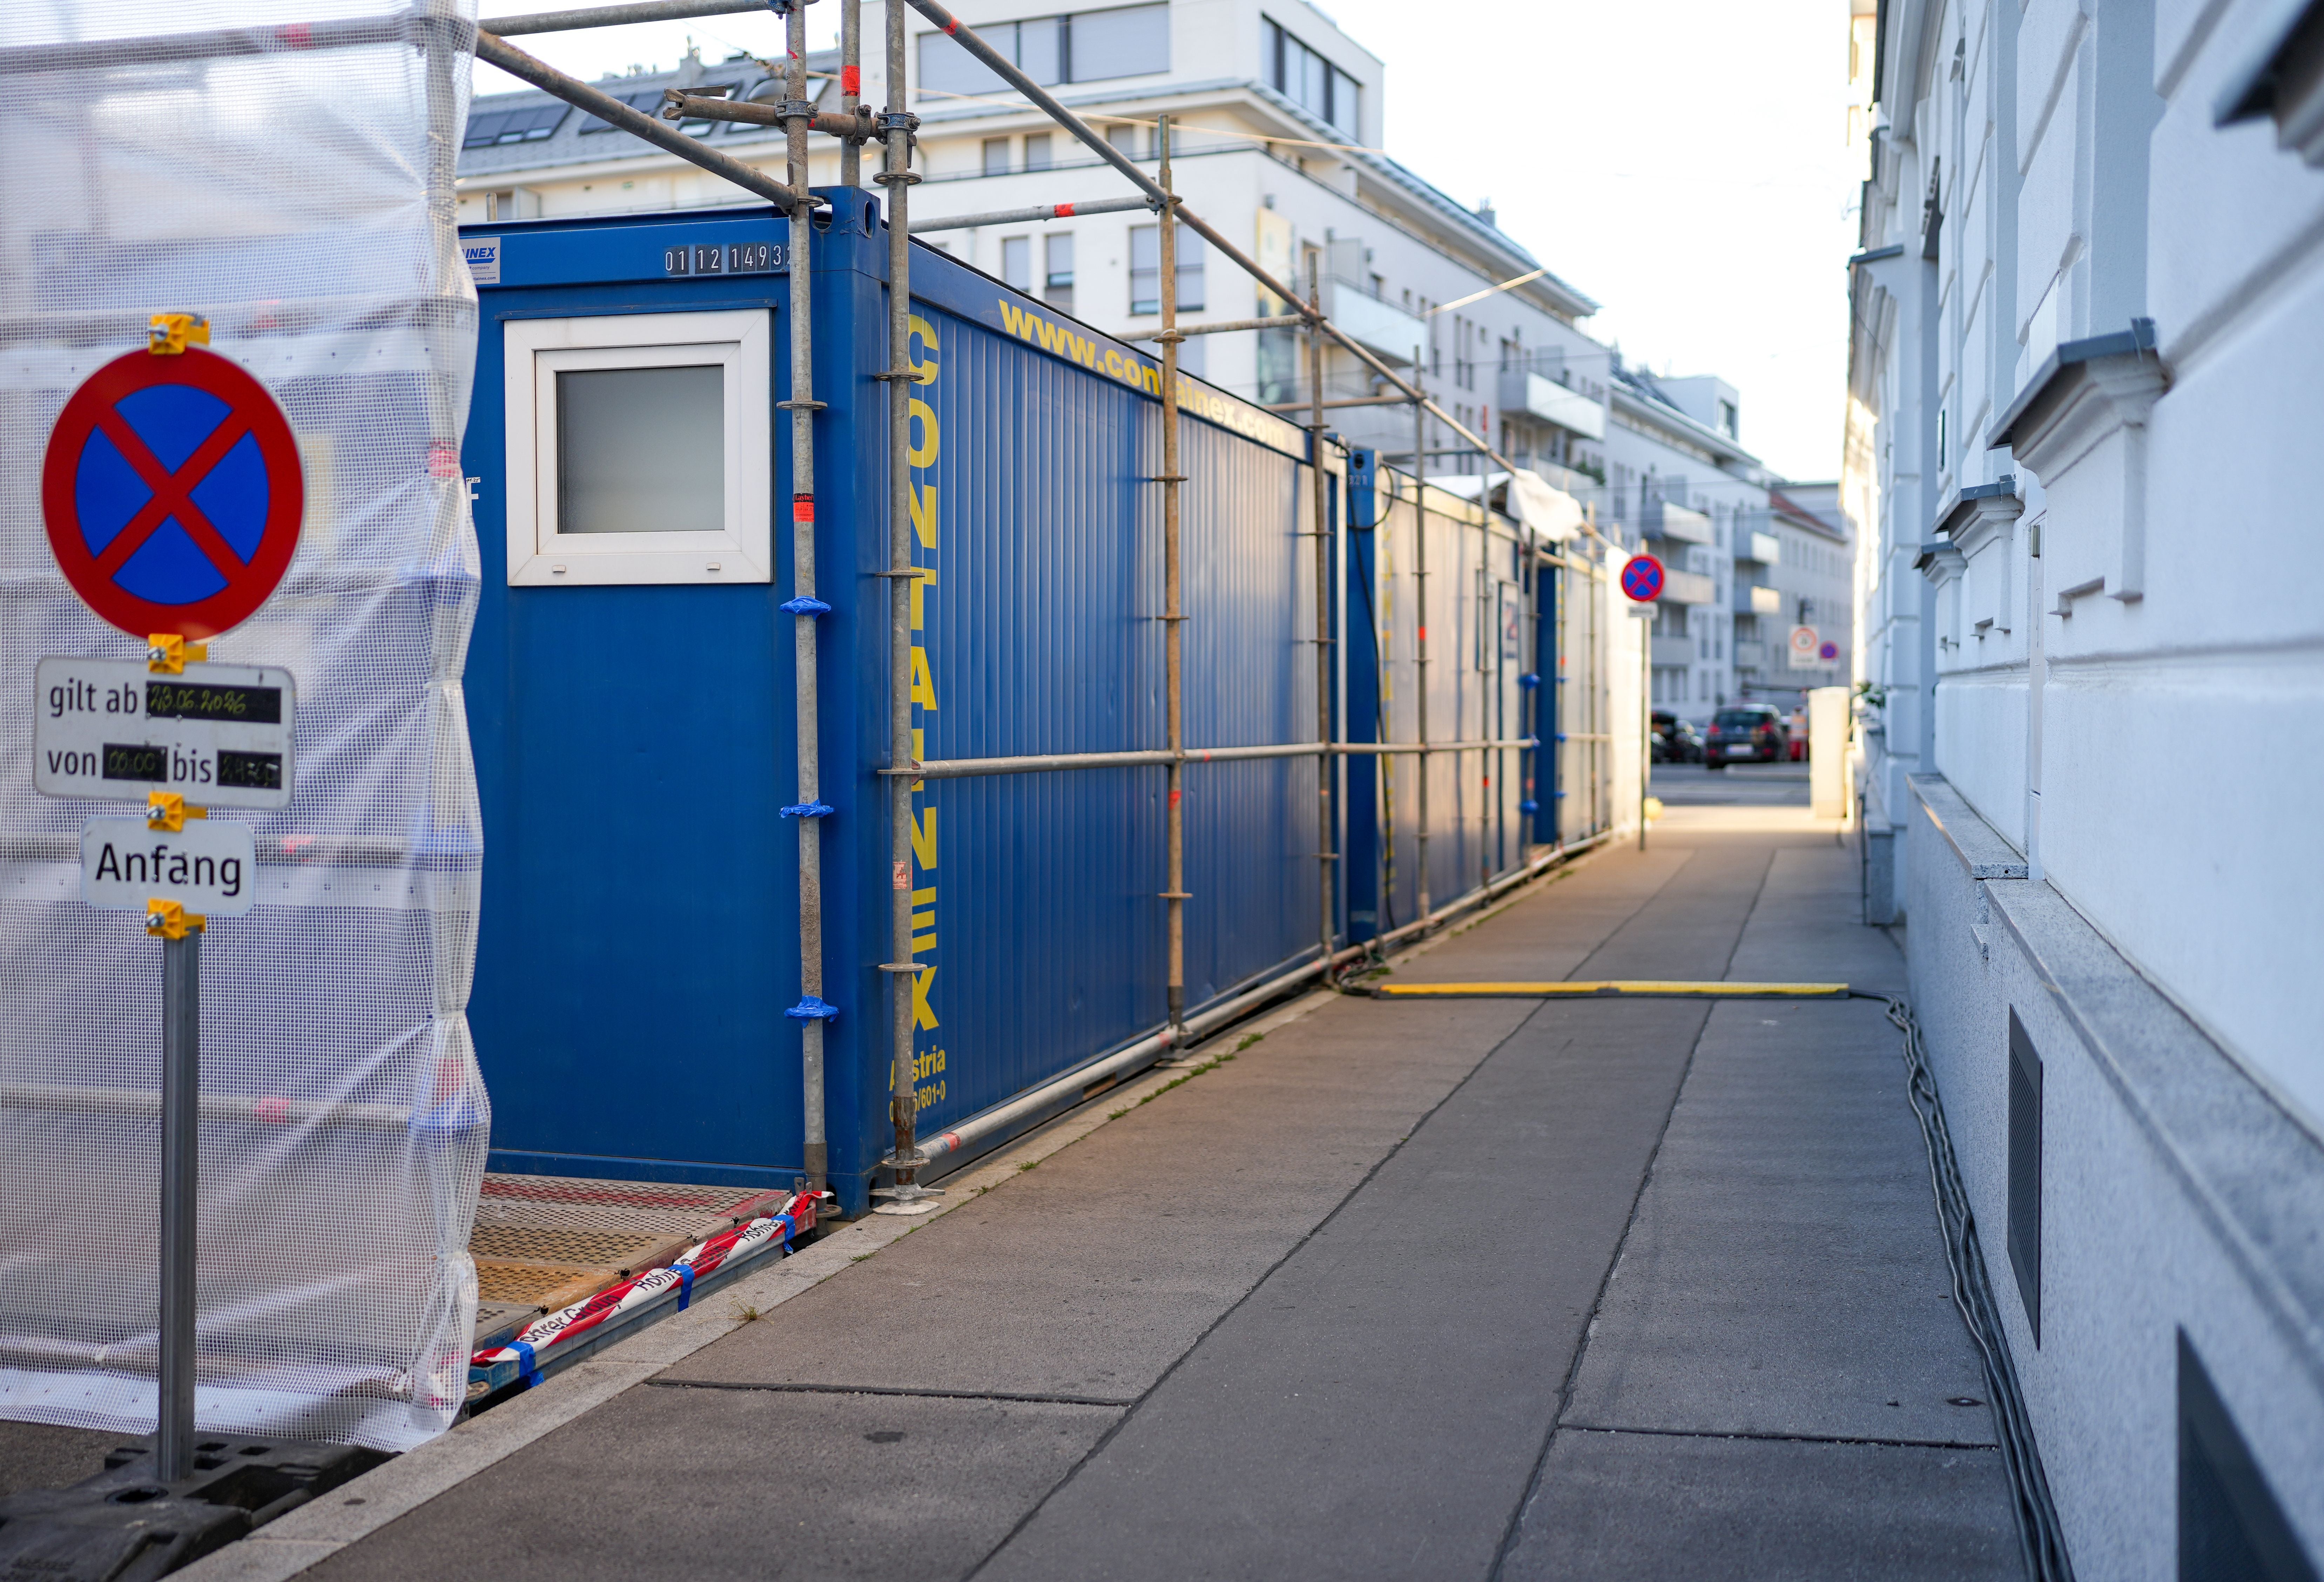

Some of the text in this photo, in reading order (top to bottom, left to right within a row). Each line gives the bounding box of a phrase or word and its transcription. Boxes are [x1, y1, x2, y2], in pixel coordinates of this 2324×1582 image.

[998, 298, 1285, 449] www.conainex.com
[49, 678, 97, 717] gilt
[106, 682, 138, 715] ab
[47, 749, 96, 776] von
[173, 749, 212, 783] bis
[95, 843, 242, 897] Anfang
[889, 1044, 946, 1091] stria
[519, 1316, 568, 1343] ohrer
